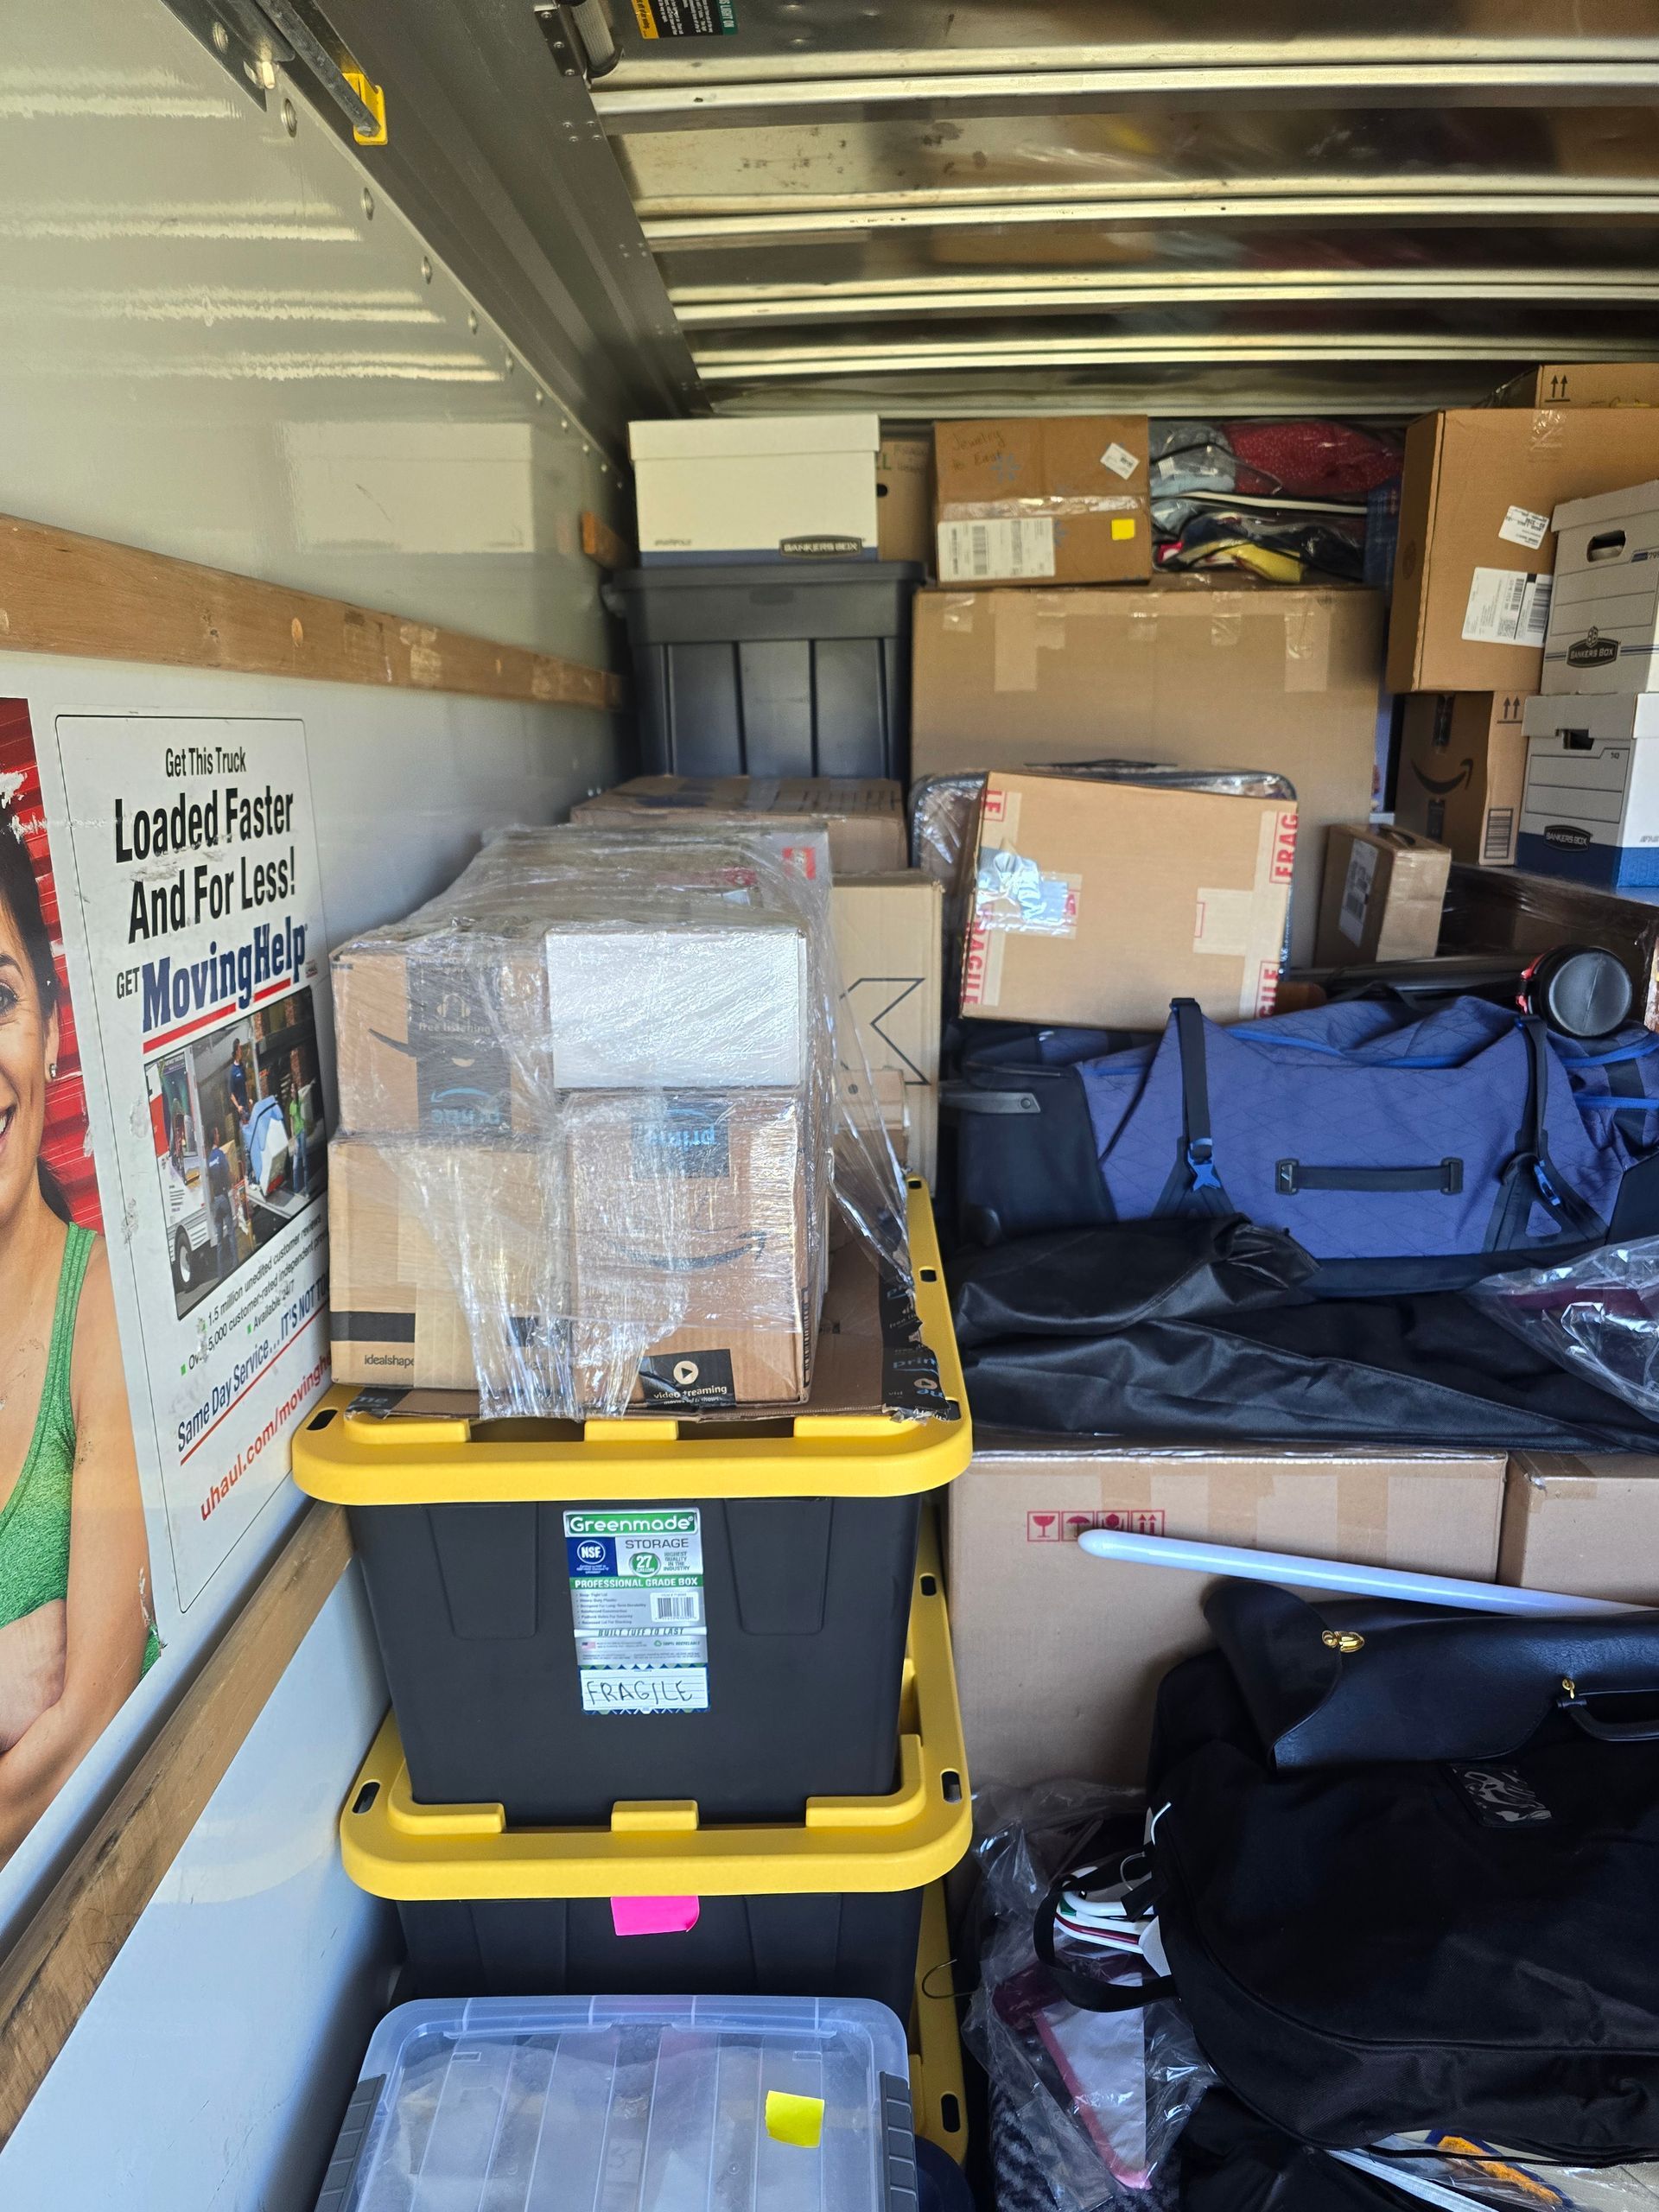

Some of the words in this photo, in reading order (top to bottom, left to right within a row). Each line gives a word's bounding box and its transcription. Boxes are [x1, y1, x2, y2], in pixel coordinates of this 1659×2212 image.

[784, 542, 831, 553] BANKERS
[835, 542, 858, 552] BOX
[1569, 649, 1598, 660] BANKERS
[1599, 646, 1614, 658] BOX
[165, 747, 187, 778] Get
[188, 747, 213, 776] This
[215, 746, 247, 774] Truck
[115, 789, 219, 863] Loaded
[226, 785, 294, 843] Faster
[1546, 832, 1574, 844] BANKERS
[1574, 836, 1588, 846] BOX
[128, 868, 187, 944] And
[194, 864, 234, 925] For
[240, 845, 296, 911] Less!
[117, 966, 141, 1000] GET
[142, 916, 306, 1033] MovingHelp
[208, 1306, 219, 1326] 1.5
[220, 1285, 243, 1316] million
[245, 1257, 273, 1294] unedited
[273, 1235, 302, 1267] customer
[302, 1214, 322, 1242] reviews
[278, 1244, 315, 1283] independent
[252, 1296, 282, 1328] Available
[178, 1401, 210, 1452] Same
[212, 1377, 232, 1417] Day
[281, 1306, 298, 1341] IT'S
[299, 1286, 318, 1322] NOT
[653, 1390, 681, 1399] video
[683, 1385, 728, 1397] treaming
[570, 1515, 690, 1532] Greenmade
[625, 1538, 690, 1549] STORAGE
[581, 1546, 601, 1559] NSF
[636, 1554, 652, 1568] 27
[575, 1580, 644, 1589] PROFESSIONAL
[645, 1579, 677, 1587] GRADE
[678, 1577, 698, 1586] BOX
[598, 1628, 623, 1637] BUILT
[626, 1628, 646, 1637] TUFF
[663, 1627, 684, 1636] LAST
[587, 1681, 693, 1706] FRAGILE
